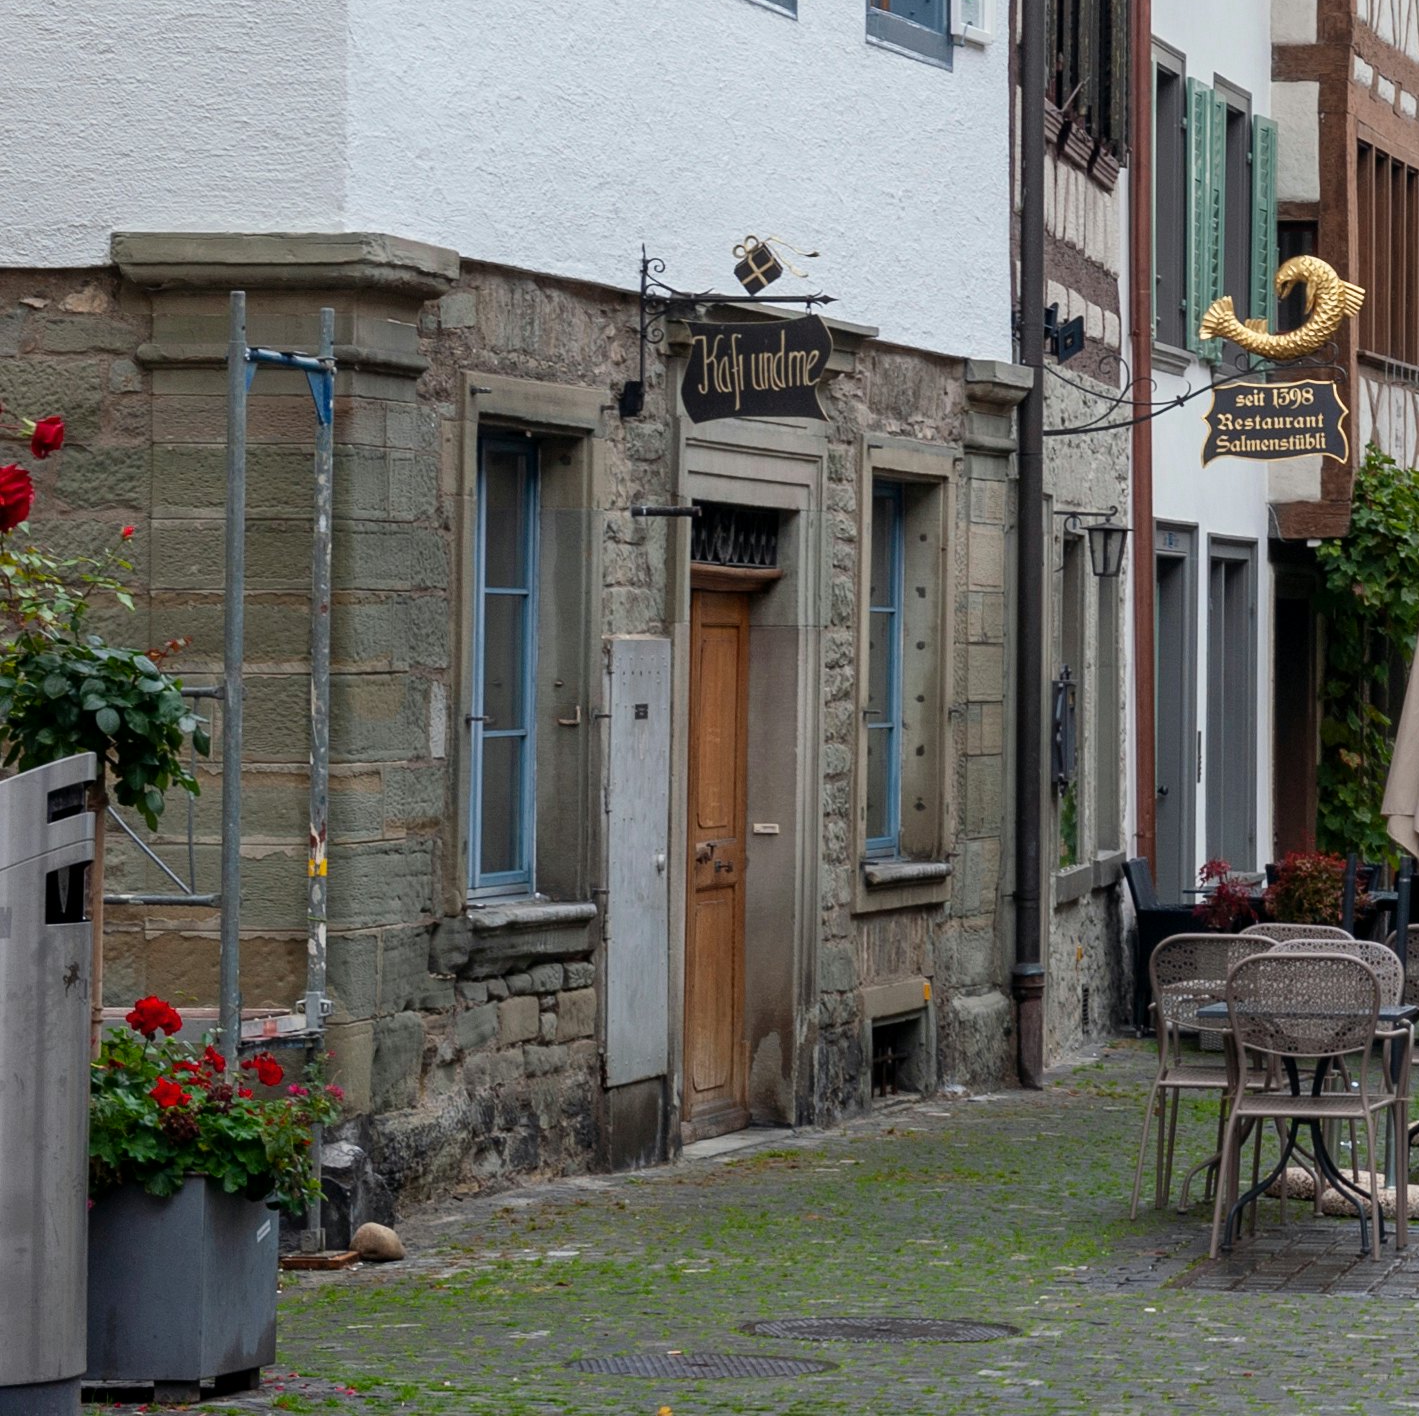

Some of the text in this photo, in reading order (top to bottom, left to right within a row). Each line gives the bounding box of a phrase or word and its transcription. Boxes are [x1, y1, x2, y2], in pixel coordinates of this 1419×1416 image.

[1235, 387, 1315, 409] seit 1398
[1216, 412, 1324, 431] Restaurant
[1215, 432, 1327, 453] Salmenstübli
